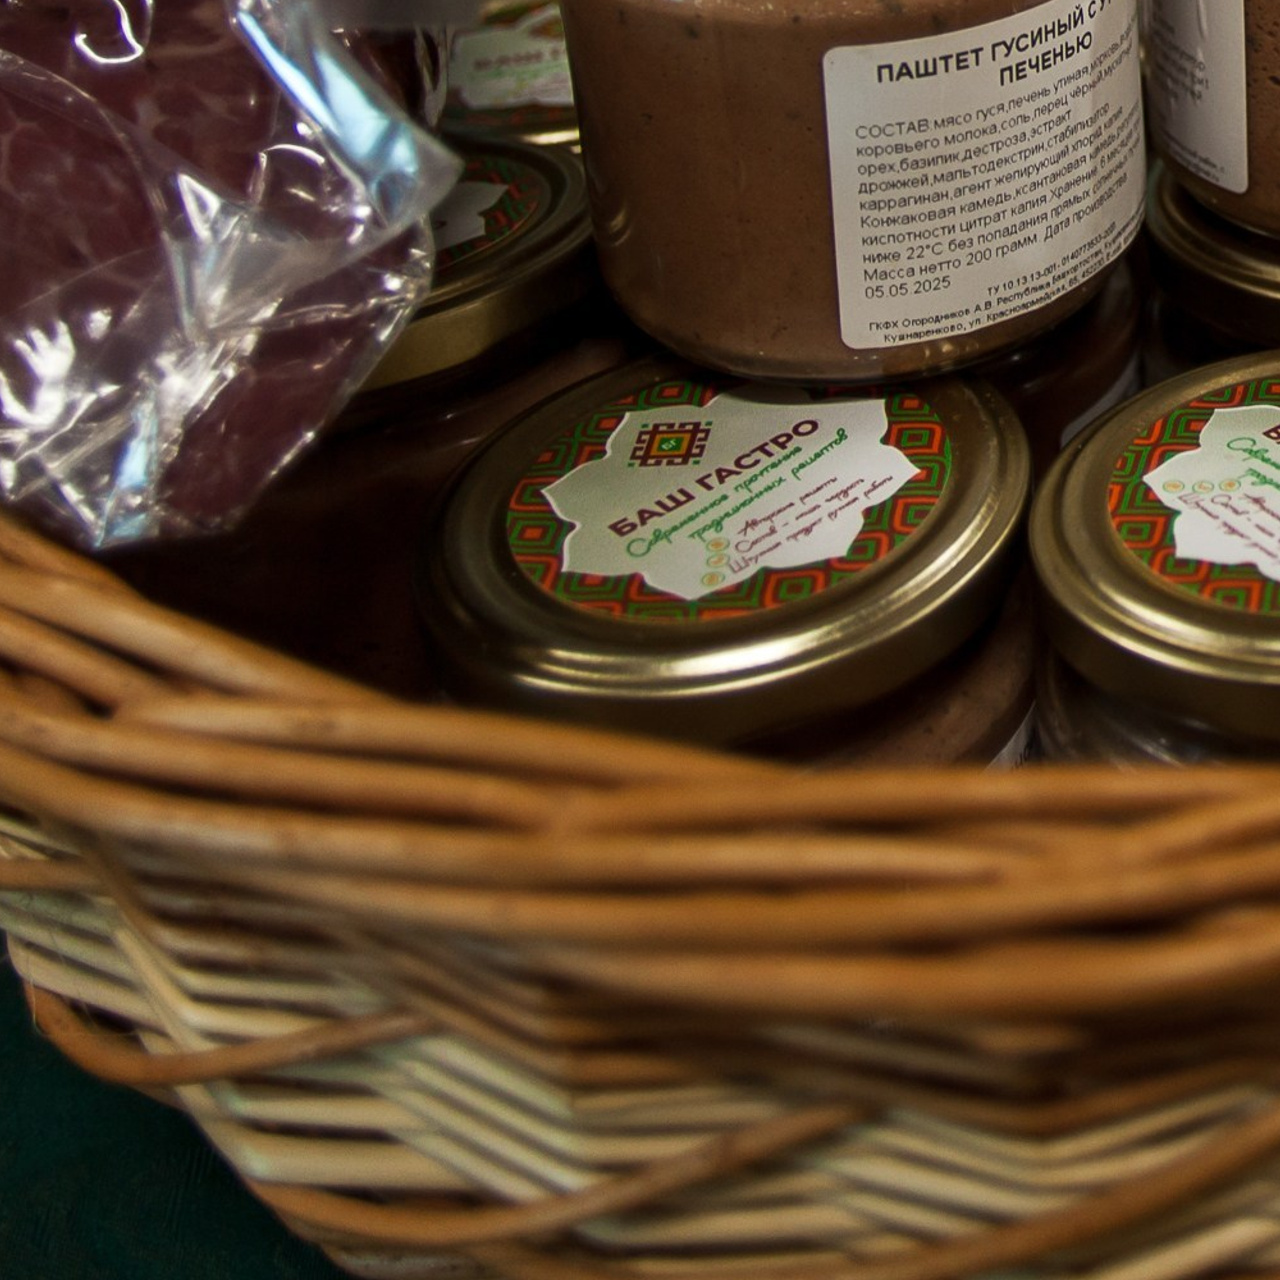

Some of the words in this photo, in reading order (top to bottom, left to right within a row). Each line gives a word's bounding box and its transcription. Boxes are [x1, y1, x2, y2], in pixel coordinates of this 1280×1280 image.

[877, 47, 984, 83] ПАШТЕТ
[991, 4, 1084, 62] ГУСИНЫЙ
[1087, 0, 1097, 19] С
[1000, 31, 1092, 87] ПЕЧЕНЬЮ
[856, 138, 940, 158] коровьего
[995, 146, 1069, 185] желирующий
[1072, 126, 1102, 153] хлорид
[861, 206, 956, 229] Конжаковая
[862, 225, 956, 247] кислотности
[960, 210, 1007, 232] цитрат
[863, 251, 901, 264] ниже
[948, 238, 974, 253] без
[977, 212, 1048, 245] попадания
[1050, 190, 1091, 219] прямых
[863, 267, 915, 282] Масса
[919, 259, 961, 276] нетто
[966, 248, 992, 267] 200
[1044, 216, 1070, 243] Дата
[865, 275, 951, 300] 05.05.2025
[869, 320, 899, 332] ГКФХ
[902, 308, 970, 328] Огородников
[997, 281, 1051, 305] Республика
[608, 487, 696, 537] БАШ
[695, 419, 819, 492] ГАСТРО
[626, 493, 729, 557] Современное
[733, 445, 803, 493] прочтение
[688, 476, 786, 543] традиционных
[790, 427, 848, 482] рецептов
